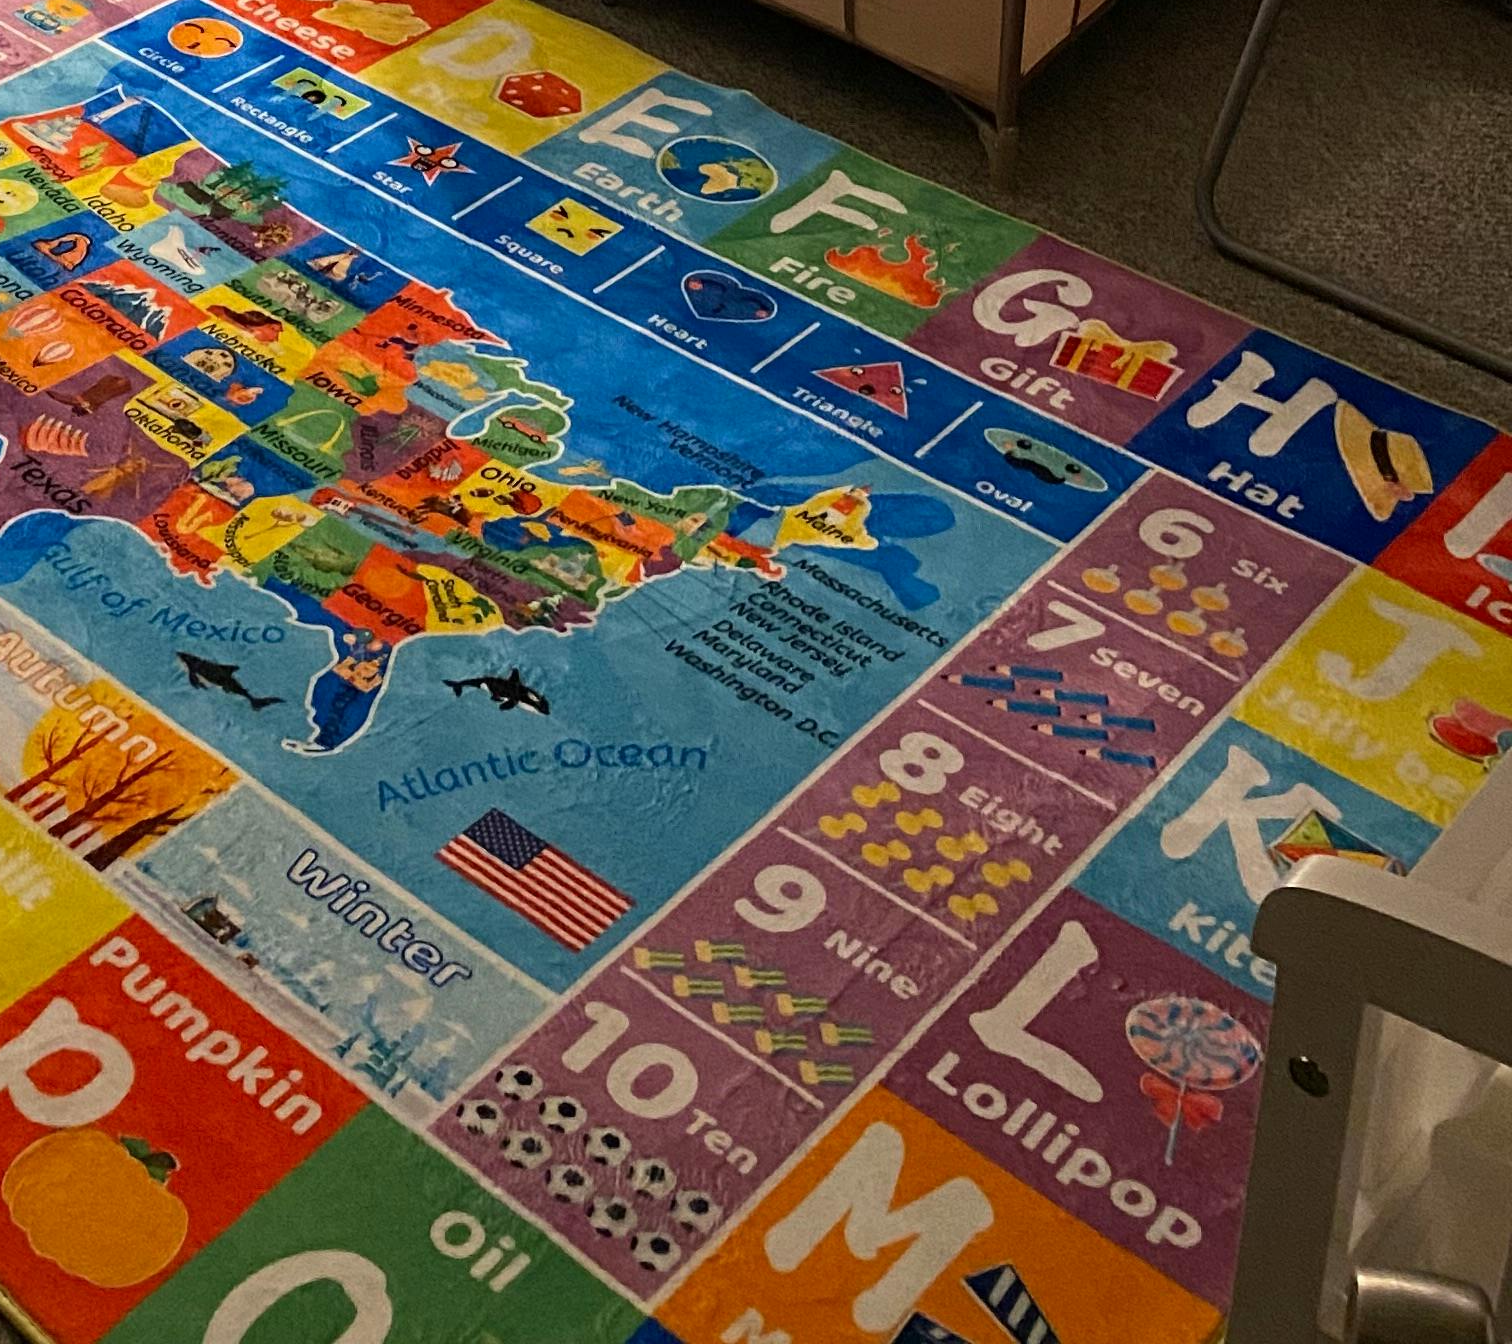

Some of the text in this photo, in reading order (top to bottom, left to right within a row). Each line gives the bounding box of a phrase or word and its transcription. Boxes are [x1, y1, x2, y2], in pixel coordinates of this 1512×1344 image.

[137, 45, 186, 75] Circle
[230, 95, 315, 145] Rectangle
[16, 166, 80, 213] Nevada
[25, 144, 75, 184] Oregon
[371, 170, 413, 196] Star
[572, 160, 684, 224] Earth
[83, 194, 136, 234] Idaho
[117, 238, 205, 295] Wyoming
[493, 233, 566, 277] Square
[769, 256, 857, 306] Fire
[58, 287, 149, 353] Colorado
[390, 294, 486, 341] Minnesota
[647, 312, 710, 352] Heart
[201, 323, 286, 376] Nebraska
[305, 371, 363, 409] Iowa
[790, 385, 887, 438] Triangle
[979, 357, 1076, 411] Gift
[124, 407, 207, 461] Oklahoma
[252, 423, 342, 481] Missouri
[472, 436, 553, 460] Michigan
[9, 454, 93, 515] Texas
[480, 466, 537, 491] Ohio
[598, 489, 688, 519] New York
[975, 479, 1034, 512] Oval
[1207, 461, 1305, 519] Hat
[795, 509, 855, 546] Maine
[1138, 507, 1217, 559] 6
[42, 539, 285, 647] Gulf of Mexico
[792, 558, 950, 649] Massachusetts
[1230, 559, 1289, 596] Six
[342, 582, 424, 635] Georgia
[748, 592, 872, 669] Connecticut
[760, 580, 906, 663] Rhode Island
[1026, 600, 1106, 653] 7
[692, 630, 805, 695] Maryland
[712, 619, 815, 682] Delaware
[730, 602, 853, 679] New Jersey
[665, 639, 839, 748] Washington D.C.
[1090, 645, 1205, 717] Seven
[376, 737, 709, 812] Atlantic Ocean
[879, 732, 965, 796] 8
[957, 784, 1067, 857] Eight
[287, 848, 472, 989] Winter
[733, 864, 827, 934] 9
[823, 929, 922, 1001] Nine
[89, 935, 323, 1135] Pumpkin
[561, 1000, 698, 1120] 10
[686, 1106, 759, 1175] Ten
[925, 1051, 1202, 1248] Lollipop
[429, 1209, 533, 1294] Oil
